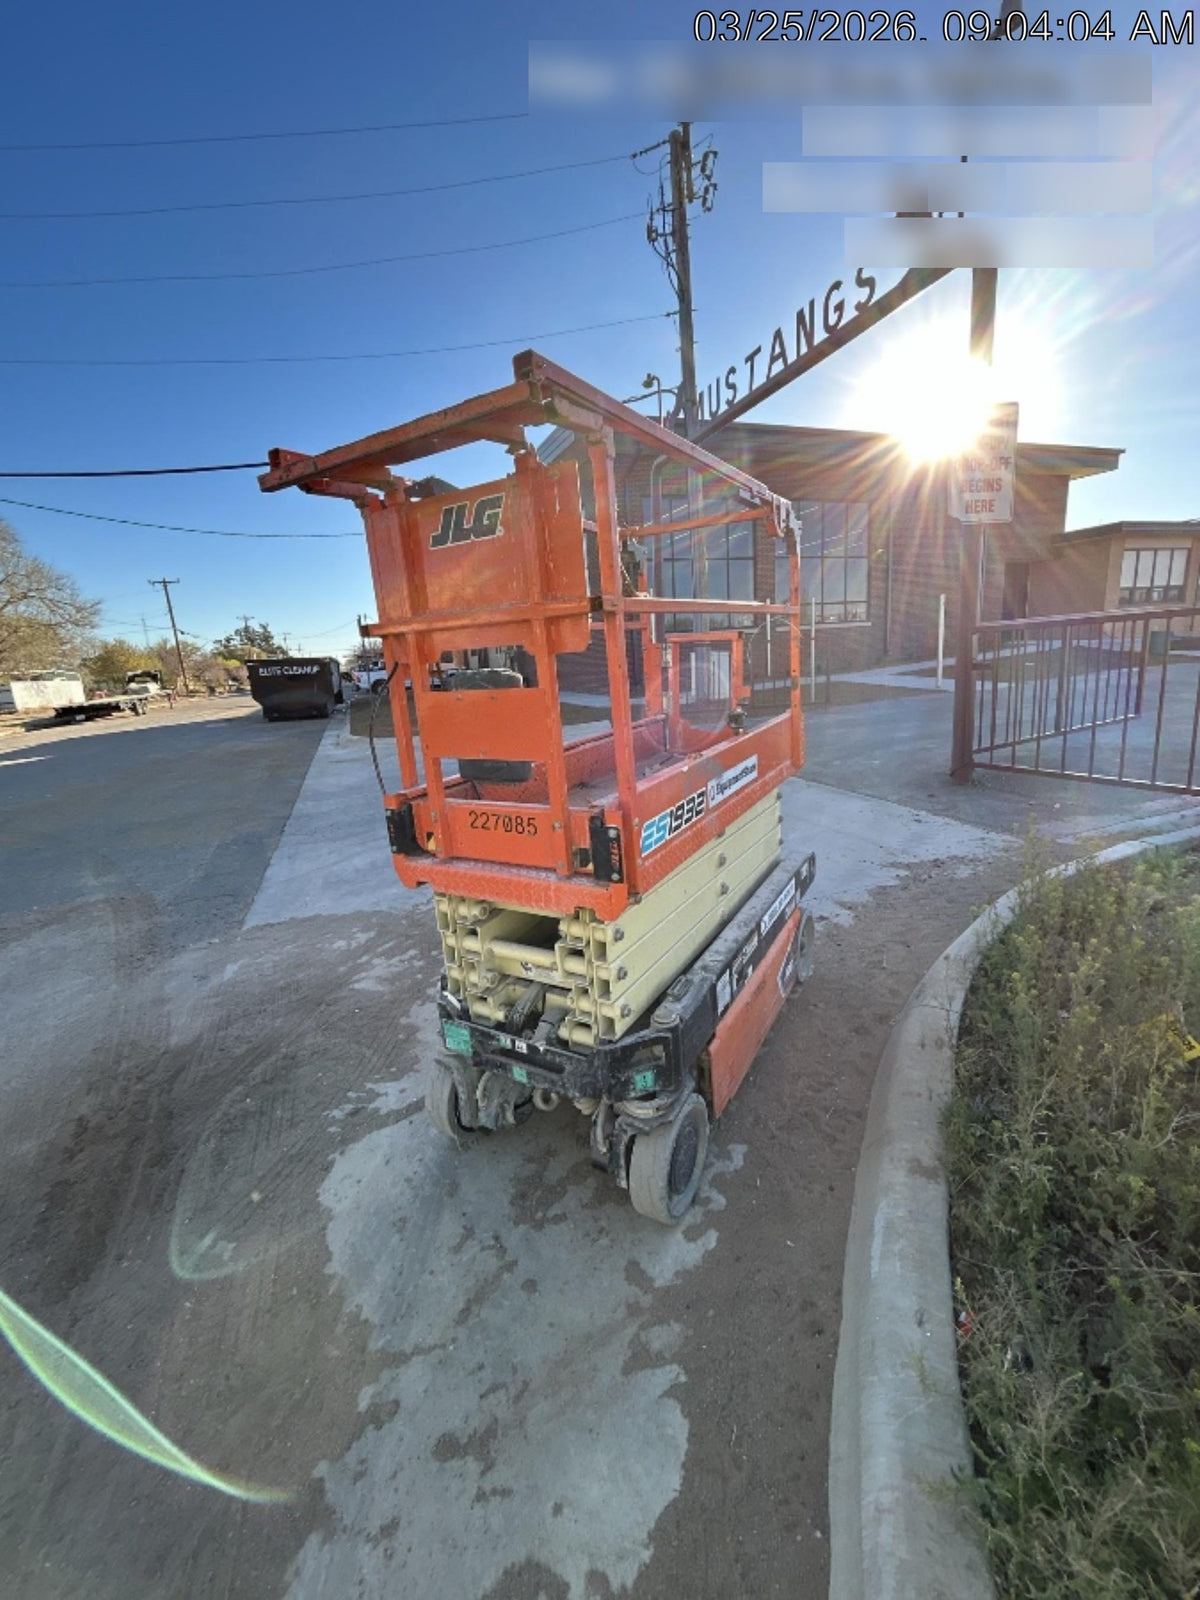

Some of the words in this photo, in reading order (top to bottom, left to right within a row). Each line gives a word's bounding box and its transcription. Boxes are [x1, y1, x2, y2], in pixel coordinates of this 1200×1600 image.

[960, 477, 1003, 493] BEGINS
[965, 499, 995, 514] HERE
[429, 493, 505, 549] JLG
[468, 810, 538, 837] 227085
[640, 787, 706, 856] ES1932
